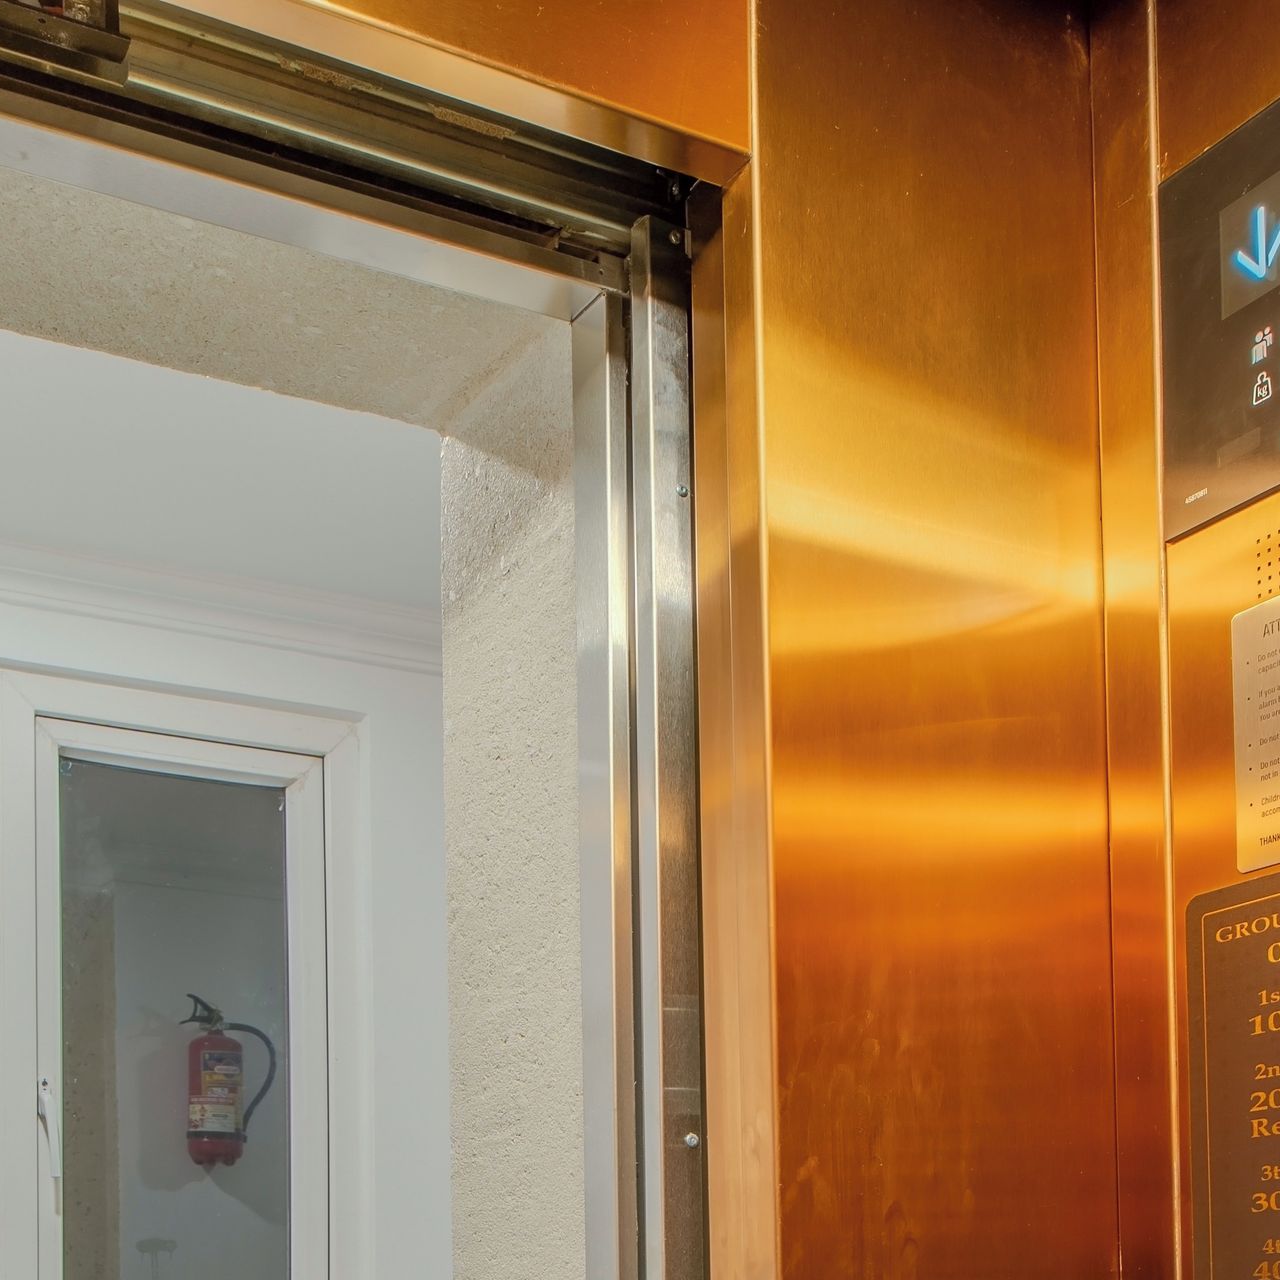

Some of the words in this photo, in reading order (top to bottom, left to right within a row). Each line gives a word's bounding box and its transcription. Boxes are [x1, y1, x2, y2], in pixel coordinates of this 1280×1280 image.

[1257, 654, 1266, 662] Do
[1267, 649, 1277, 658] not
[1264, 687, 1276, 698] you
[1259, 699, 1277, 710] alarm
[1259, 738, 1268, 746] Do
[1268, 733, 1279, 743] not
[1260, 761, 1269, 770] Do
[1269, 757, 1280, 766] not
[1260, 773, 1271, 781] not
[1272, 770, 1279, 778] in
